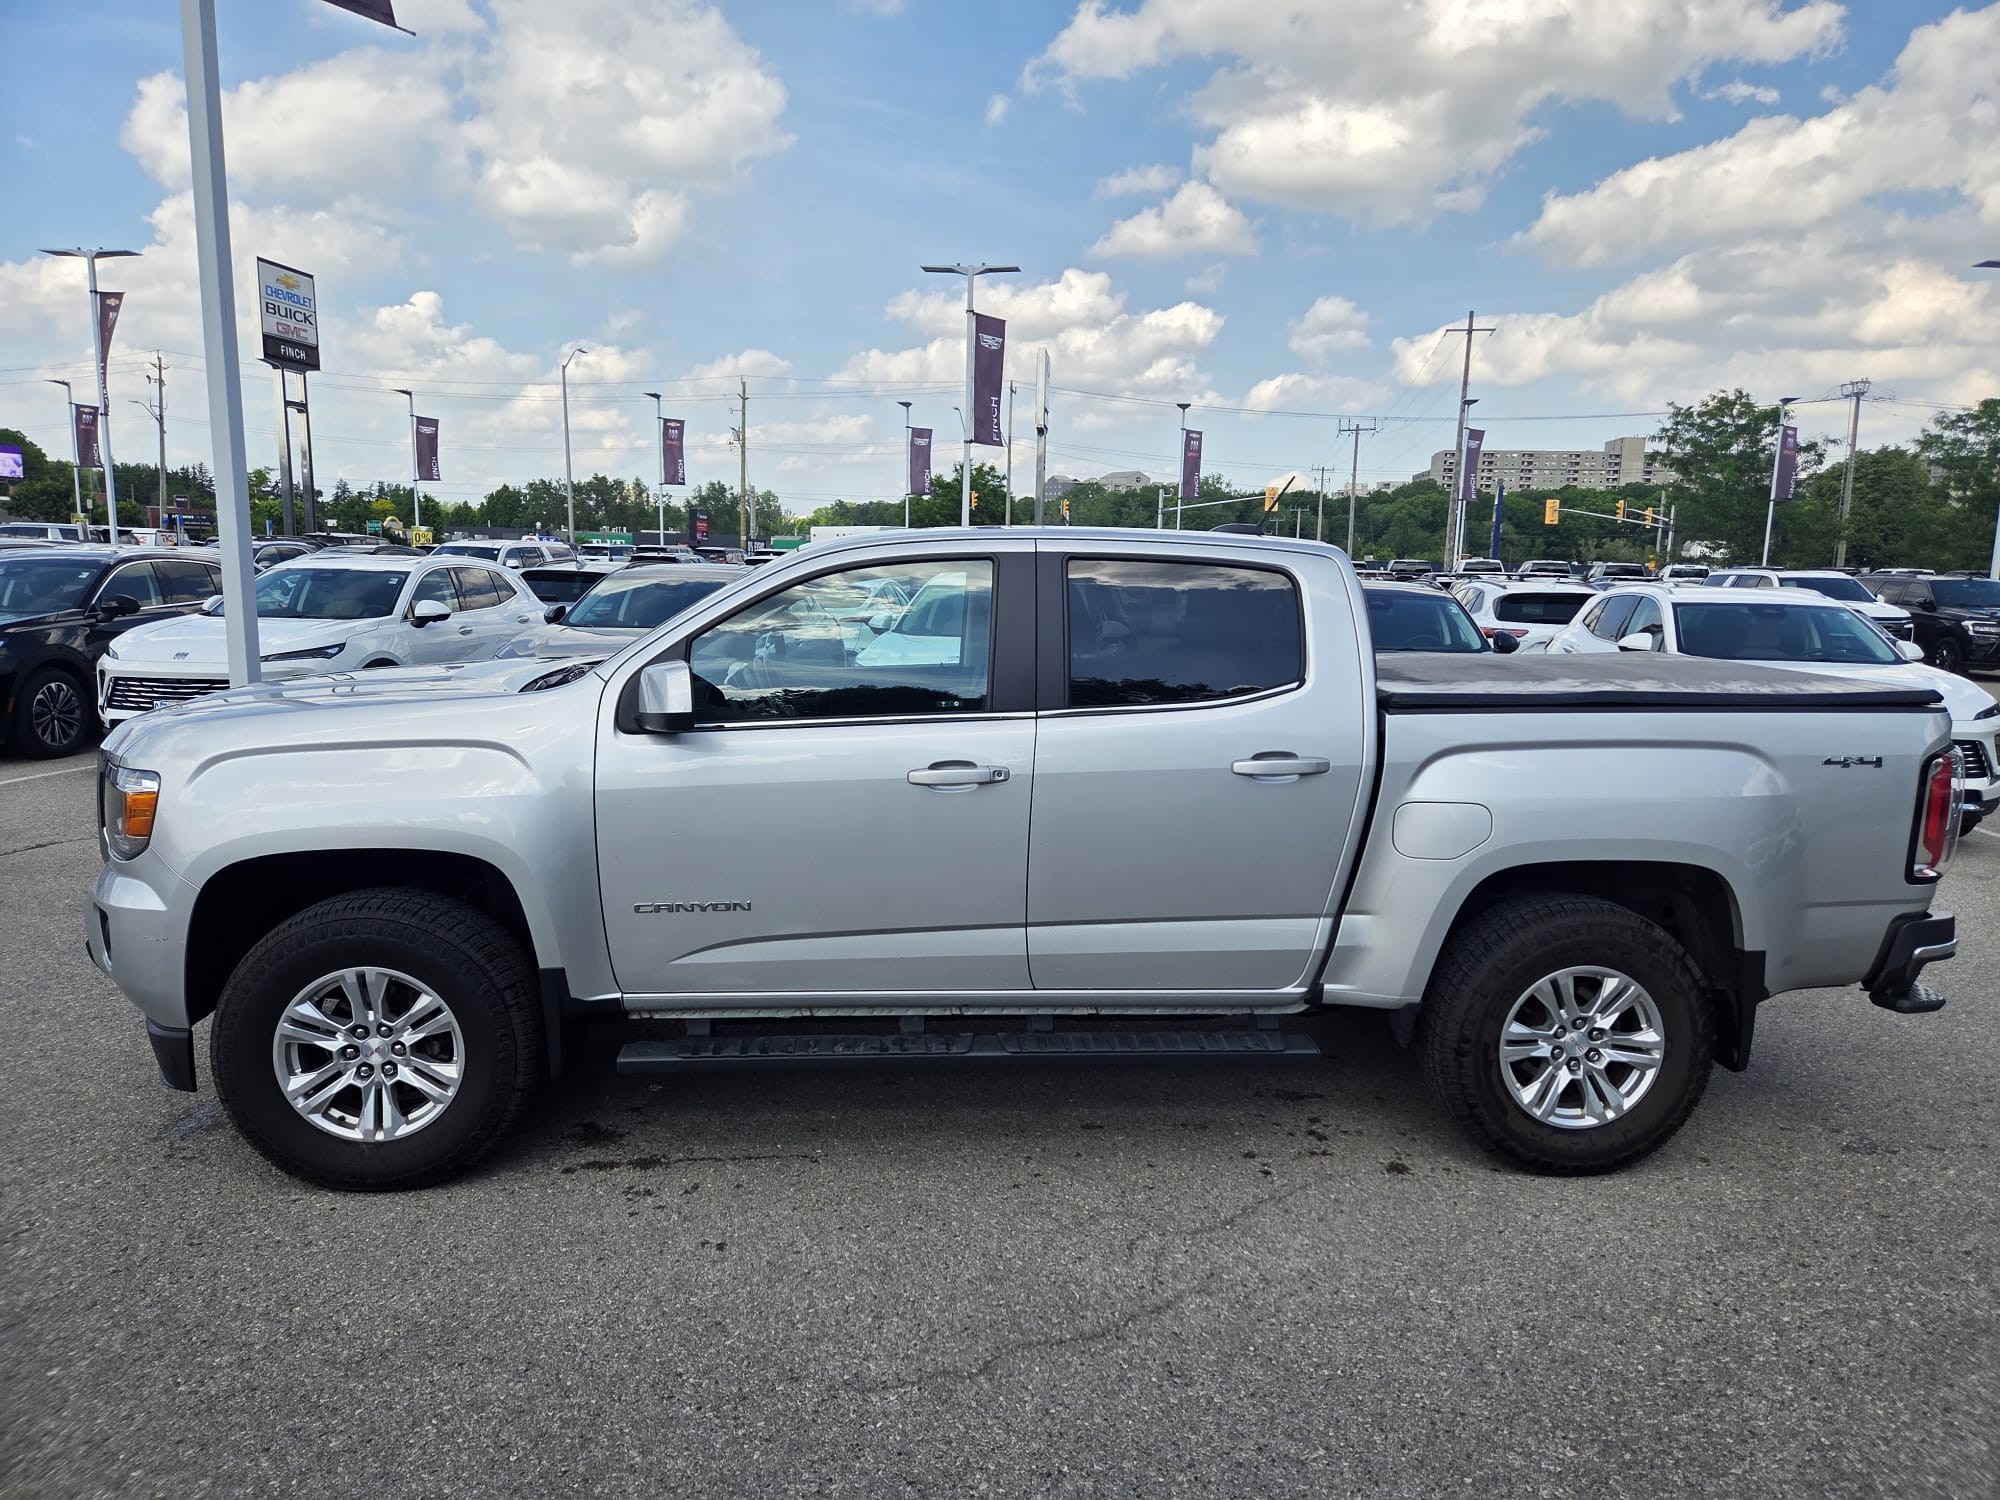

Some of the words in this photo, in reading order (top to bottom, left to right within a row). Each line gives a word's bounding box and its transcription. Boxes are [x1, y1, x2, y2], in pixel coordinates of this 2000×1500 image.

[265, 285, 312, 309] CHEVROLET
[265, 301, 314, 326] BUICK
[276, 321, 309, 341] GMC
[280, 345, 306, 360] FINCH
[990, 396, 1000, 441] FINCH
[431, 456, 440, 479] FINCH
[414, 532, 431, 543] 0%
[633, 900, 752, 914] CANYON
